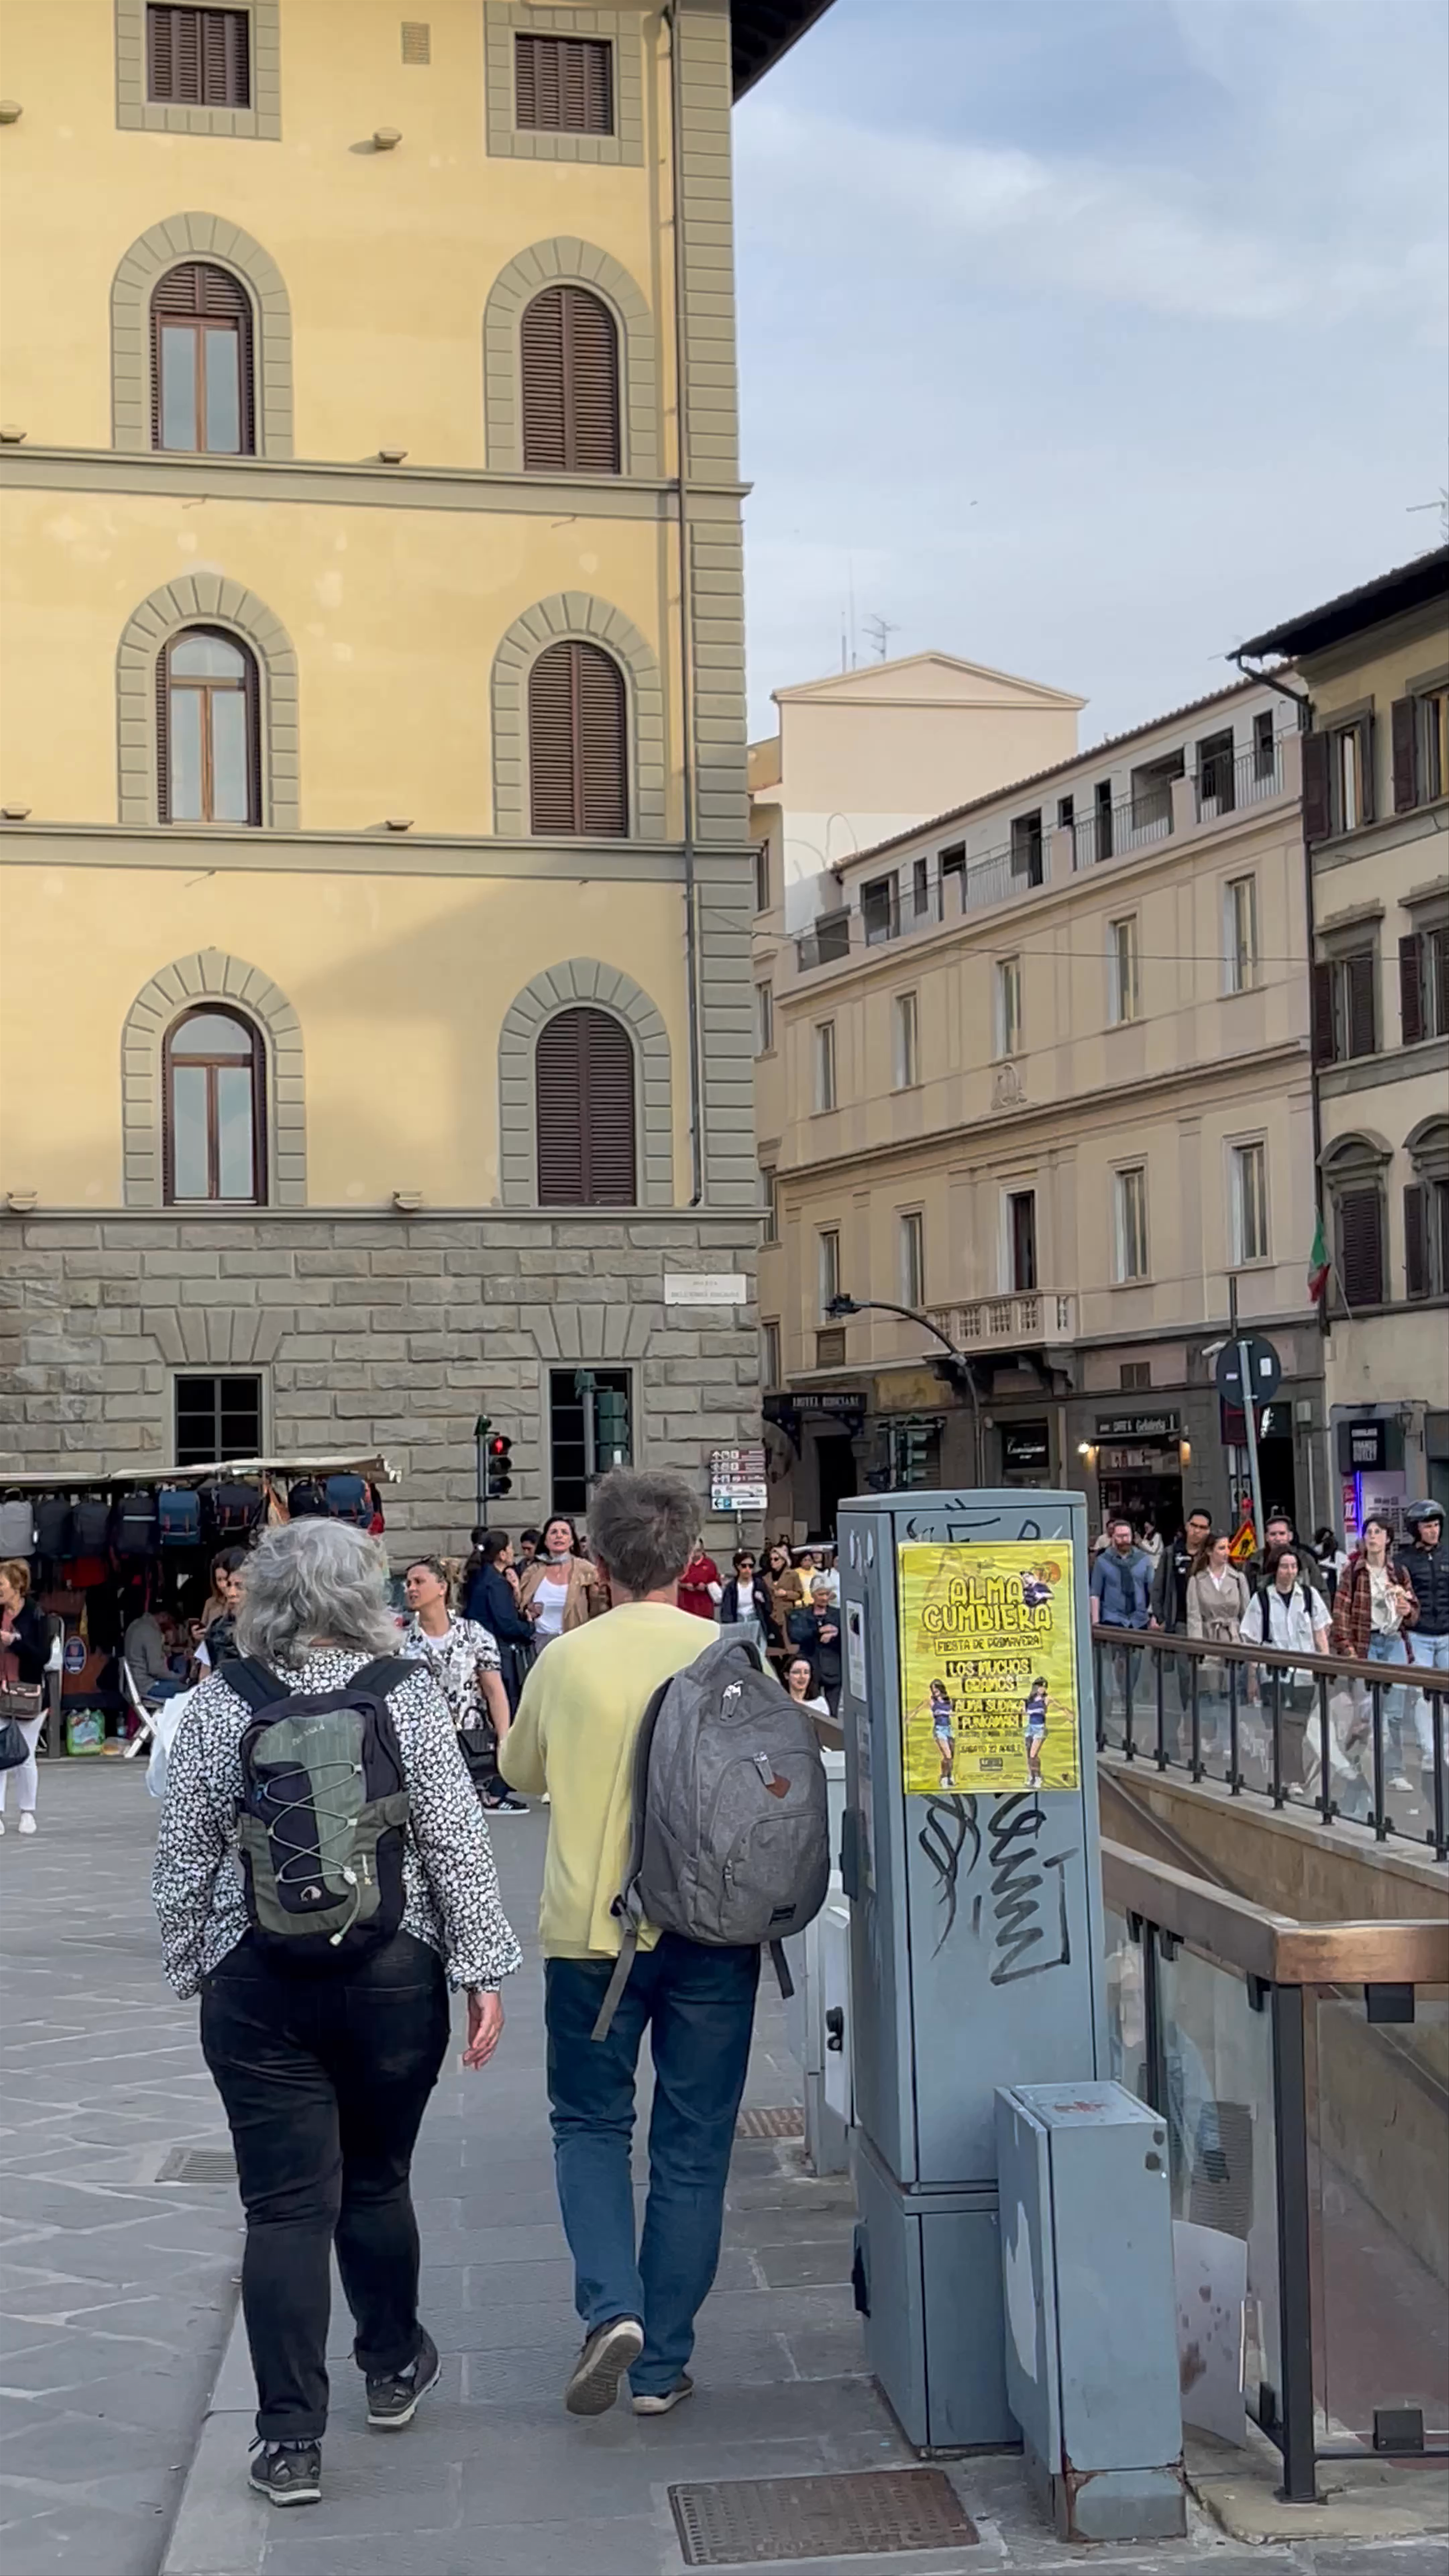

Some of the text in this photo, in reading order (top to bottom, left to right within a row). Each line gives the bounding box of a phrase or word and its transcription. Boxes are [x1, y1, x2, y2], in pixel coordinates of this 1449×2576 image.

[949, 1576, 1024, 1605] ALMA
[922, 1603, 1052, 1633] CUMBIERA
[938, 1639, 970, 1652] FIESTA
[973, 1638, 984, 1649] DE
[948, 1659, 1029, 1676] LOS MUCHOS
[955, 1699, 982, 1712] ALMA
